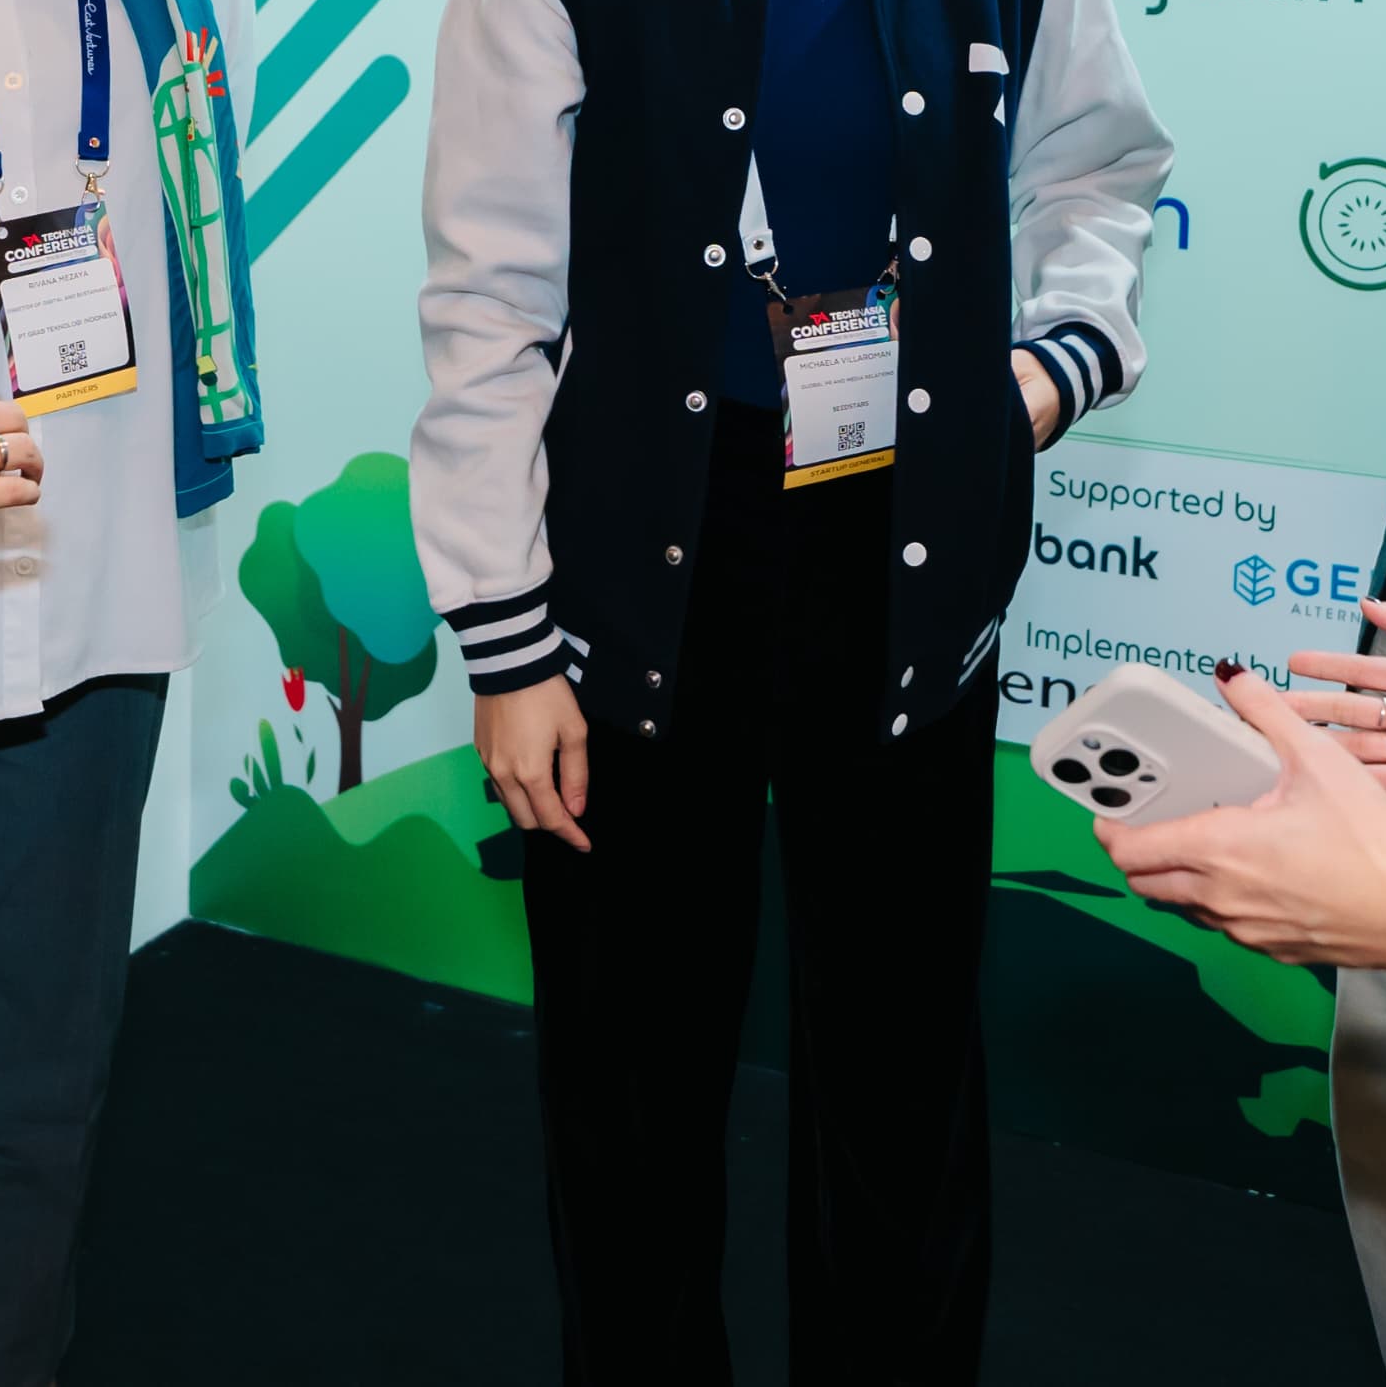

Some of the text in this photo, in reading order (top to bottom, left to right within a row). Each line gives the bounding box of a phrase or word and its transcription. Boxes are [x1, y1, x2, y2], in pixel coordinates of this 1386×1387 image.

[4, 233, 97, 263] CONFERENCE
[790, 314, 888, 339] CONFERENCE
[800, 358, 839, 370] MICHAELA
[55, 384, 99, 400] PARTNERS
[810, 463, 848, 478] STARTUP
[1049, 470, 1277, 533] Supported by
[1034, 521, 1159, 581] bank
[1025, 621, 1241, 676] Implemente
